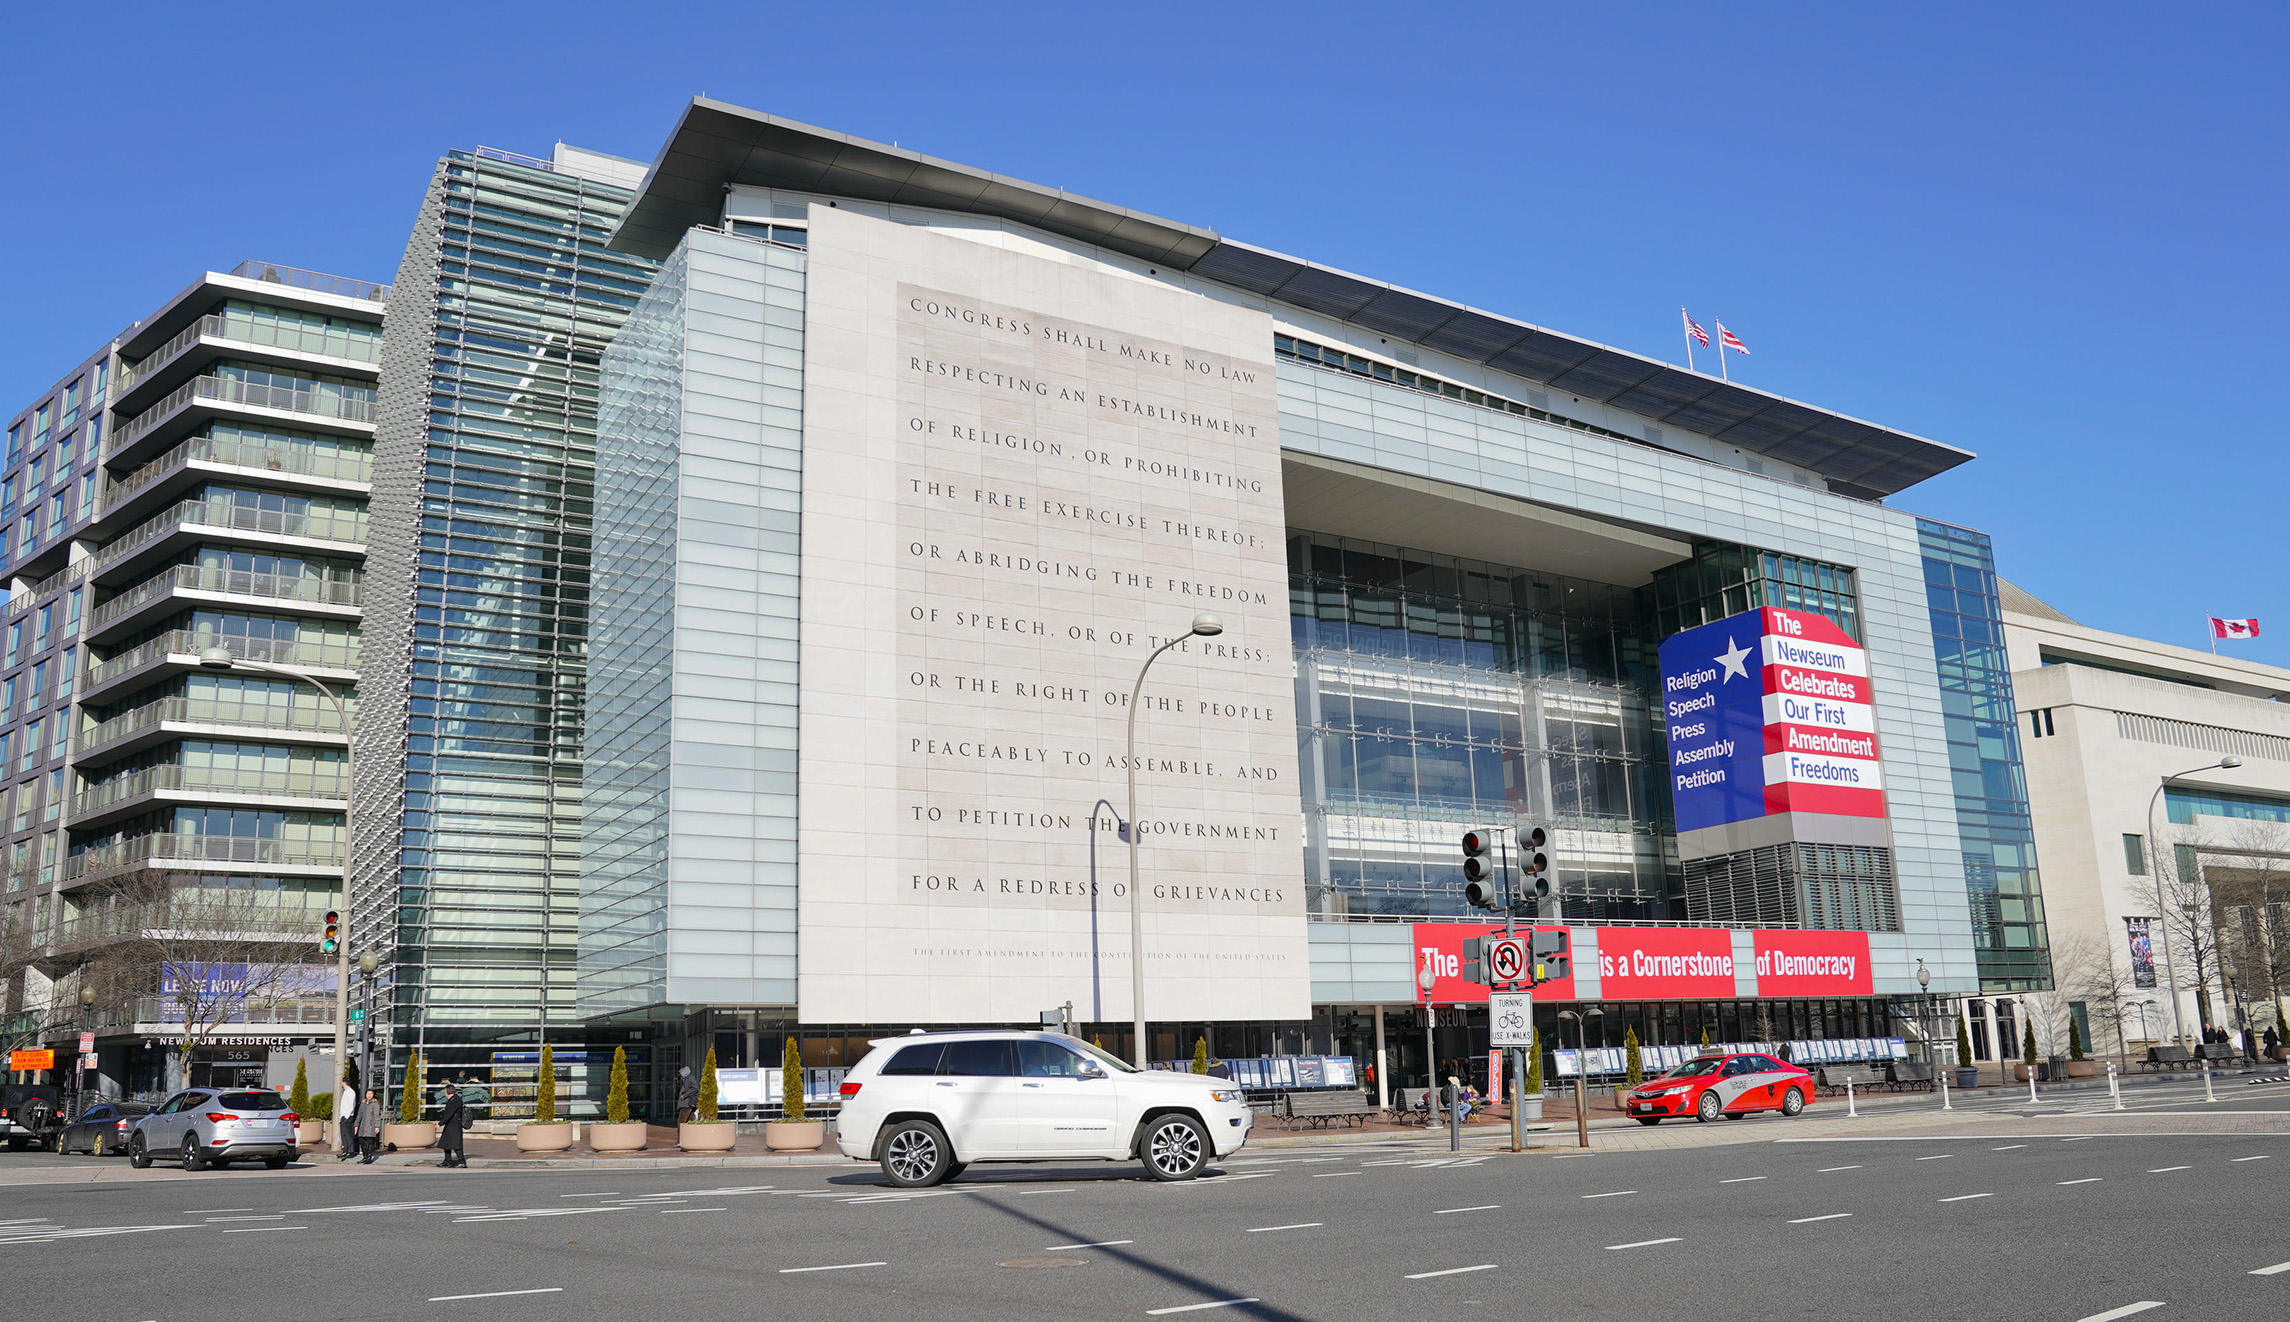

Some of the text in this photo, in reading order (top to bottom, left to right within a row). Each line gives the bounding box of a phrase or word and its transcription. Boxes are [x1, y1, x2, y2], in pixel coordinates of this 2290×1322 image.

[910, 298, 1256, 384] CONGRESS SHALL MAKE NO LAW
[911, 357, 1258, 438] RESPECTING AN ESTABLISHMENT
[910, 418, 936, 433] OF
[1084, 449, 1111, 466] OR
[1125, 456, 1262, 493] PROHIBITING
[911, 479, 1264, 549] THE FREE EXERCISE THEREOF;
[910, 542, 1267, 605] OR ABRIDGING THE FREEDOM
[910, 606, 938, 622] OF
[1068, 626, 1096, 642] OR
[1110, 631, 1134, 646] OF
[1149, 635, 1188, 652] THE
[1204, 643, 1270, 663] PRESS;
[1773, 611, 1802, 635] The
[1777, 640, 1845, 669] Newseum
[1666, 668, 1717, 692] Religion
[1781, 669, 1856, 699] Celebrates
[910, 672, 1273, 722] OR THE RIGHT OF THE PEOPLE
[1668, 692, 1715, 718] Speech
[1785, 699, 1846, 725] Our First
[1672, 722, 1705, 741] Press
[1789, 727, 1874, 757] Amendment
[912, 738, 1048, 762] PEACEABLY
[1063, 751, 1091, 766] TO
[1237, 766, 1278, 781] AND
[1675, 739, 1734, 766] Assembly
[1676, 769, 1725, 791] Petition
[1791, 757, 1859, 782] Freedoms
[911, 806, 1279, 841] TO PETITION THE GOVERNMENT
[913, 875, 959, 891] FOR
[973, 878, 985, 892] A
[1000, 879, 1098, 897] REDRESS
[1153, 885, 1283, 902] GRIEVANCES
[914, 948, 934, 956] THE
[941, 949, 971, 957] FIRST
[977, 950, 1044, 958] AMENDMENT
[1094, 952, 1171, 960] CONSTITION
[1255, 954, 1286, 962] STATES
[1422, 948, 1856, 980] The is a Cornerstone of Democracy
[1498, 999, 1523, 1007] TURNING
[221, 1037, 291, 1046] RESIDENCES
[1493, 1031, 1531, 1040] USE X-WALKS
[228, 1051, 250, 1060] 565
[1492, 1053, 1501, 1101] OPEN
